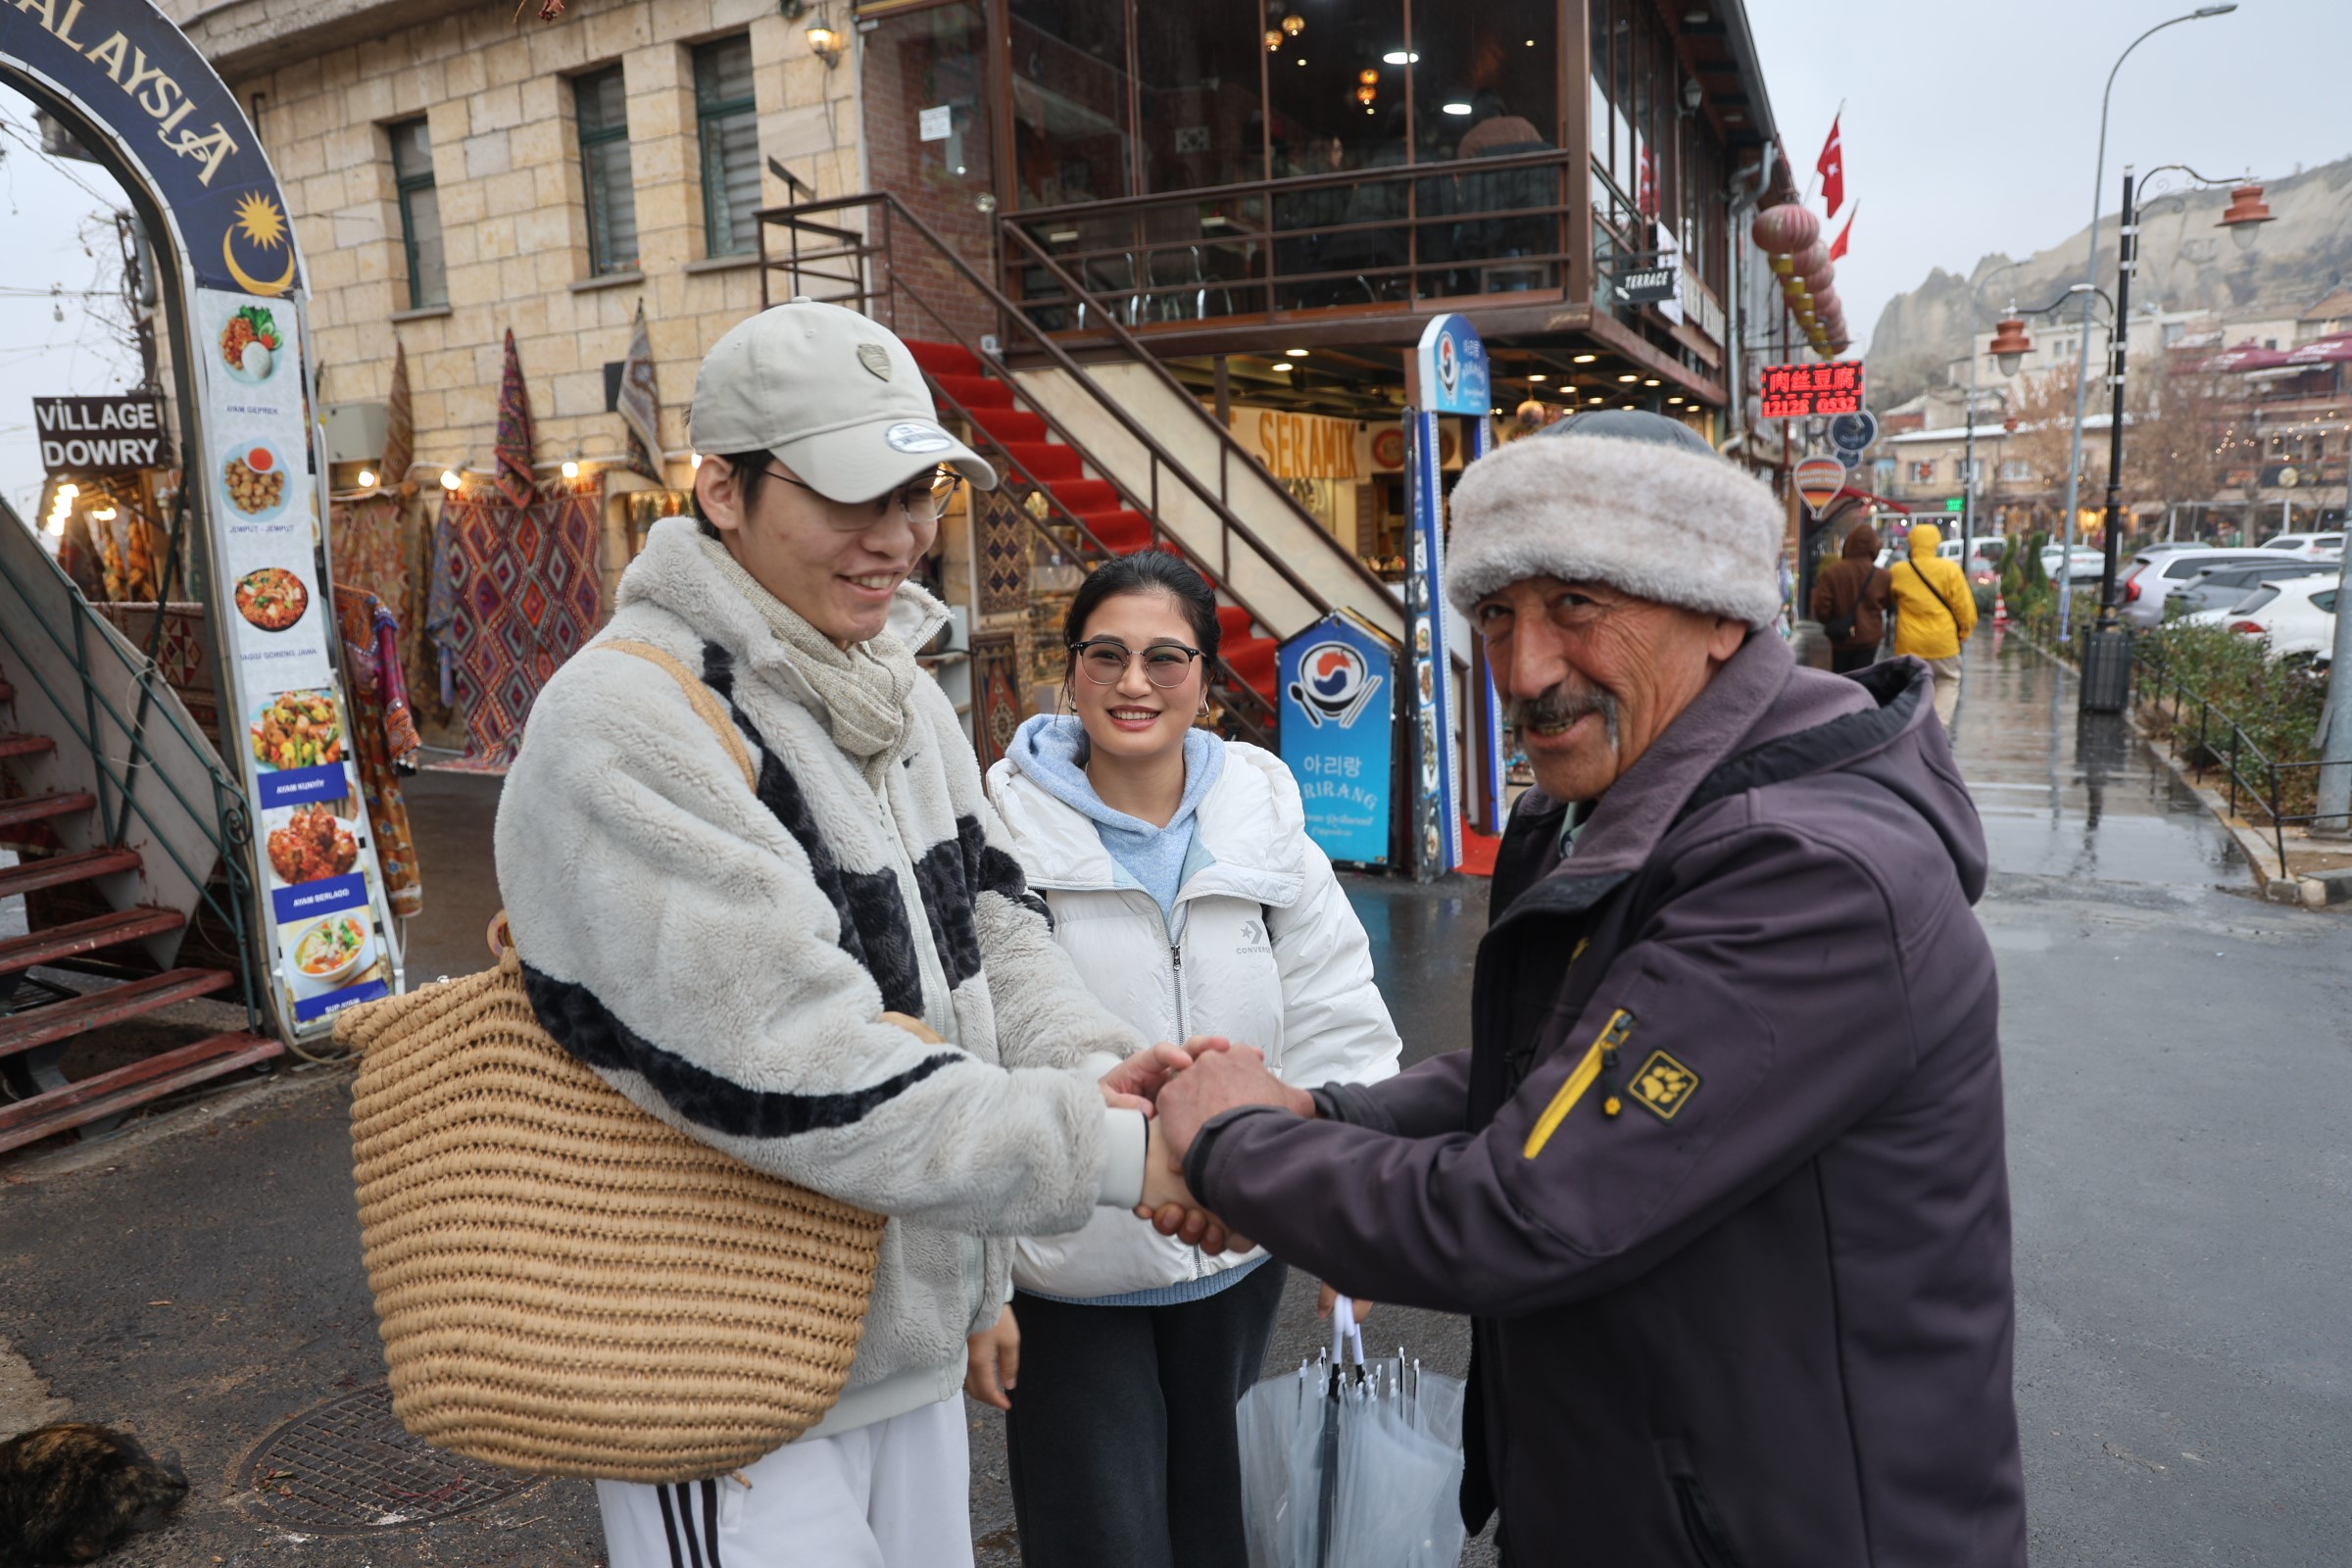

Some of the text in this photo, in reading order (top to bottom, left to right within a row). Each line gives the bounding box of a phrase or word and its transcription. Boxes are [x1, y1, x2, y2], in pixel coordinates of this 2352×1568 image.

[0, 0, 239, 187] ALAYSIA
[1624, 270, 1669, 290] TERRACE
[1769, 367, 1856, 393] 肉丝豆腐
[42, 437, 159, 466] DOWRY
[1258, 411, 1358, 479] SERAMIK
[1303, 754, 1362, 778] 아리랑
[1301, 780, 1379, 811] RIRANG
